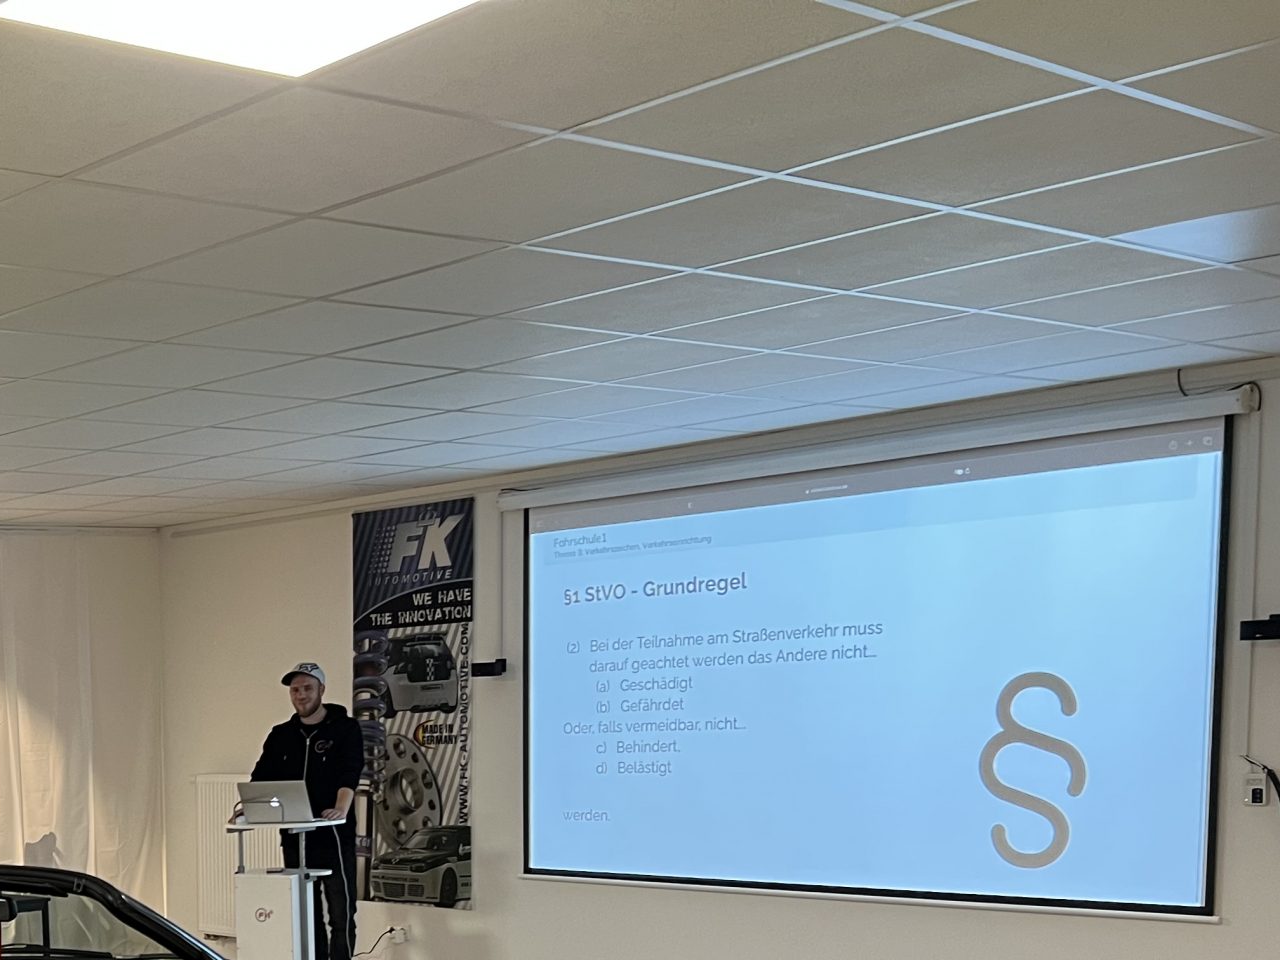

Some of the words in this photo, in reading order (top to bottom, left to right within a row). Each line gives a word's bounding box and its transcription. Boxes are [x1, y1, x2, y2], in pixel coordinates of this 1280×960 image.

[387, 513, 465, 573] FK
[368, 568, 453, 586] UTOMOTIVE
[585, 584, 625, 602] StVO
[643, 572, 748, 597] Grundregel
[413, 592, 432, 606] WE
[438, 588, 471, 604] HAVE
[370, 612, 392, 626] THE
[398, 604, 471, 624] INNOVATION
[566, 641, 580, 654] (2)
[590, 639, 609, 653] Bei
[612, 638, 633, 651] der
[637, 634, 704, 649] Teilnahme
[707, 633, 728, 645] am
[732, 624, 839, 643] Straßenverkehr
[842, 622, 883, 637] muss
[589, 658, 629, 673] darauf
[631, 655, 689, 673] geachtet
[692, 652, 744, 668] werden
[747, 651, 772, 665] das
[775, 648, 827, 663] Andere
[596, 680, 610, 693] (a)
[620, 676, 693, 693] Geschädigt
[596, 700, 610, 714] (b)
[620, 698, 684, 712] Gefährdet
[422, 724, 444, 735] MADE
[445, 724, 454, 734] IN
[459, 622, 470, 825] WWW.FK-AUTOMOTIVE.COM
[598, 721, 622, 734] falls
[422, 735, 458, 746] GERMANY
[596, 742, 607, 754] c)
[596, 762, 608, 775] d)
[618, 761, 672, 777] Belästigt
